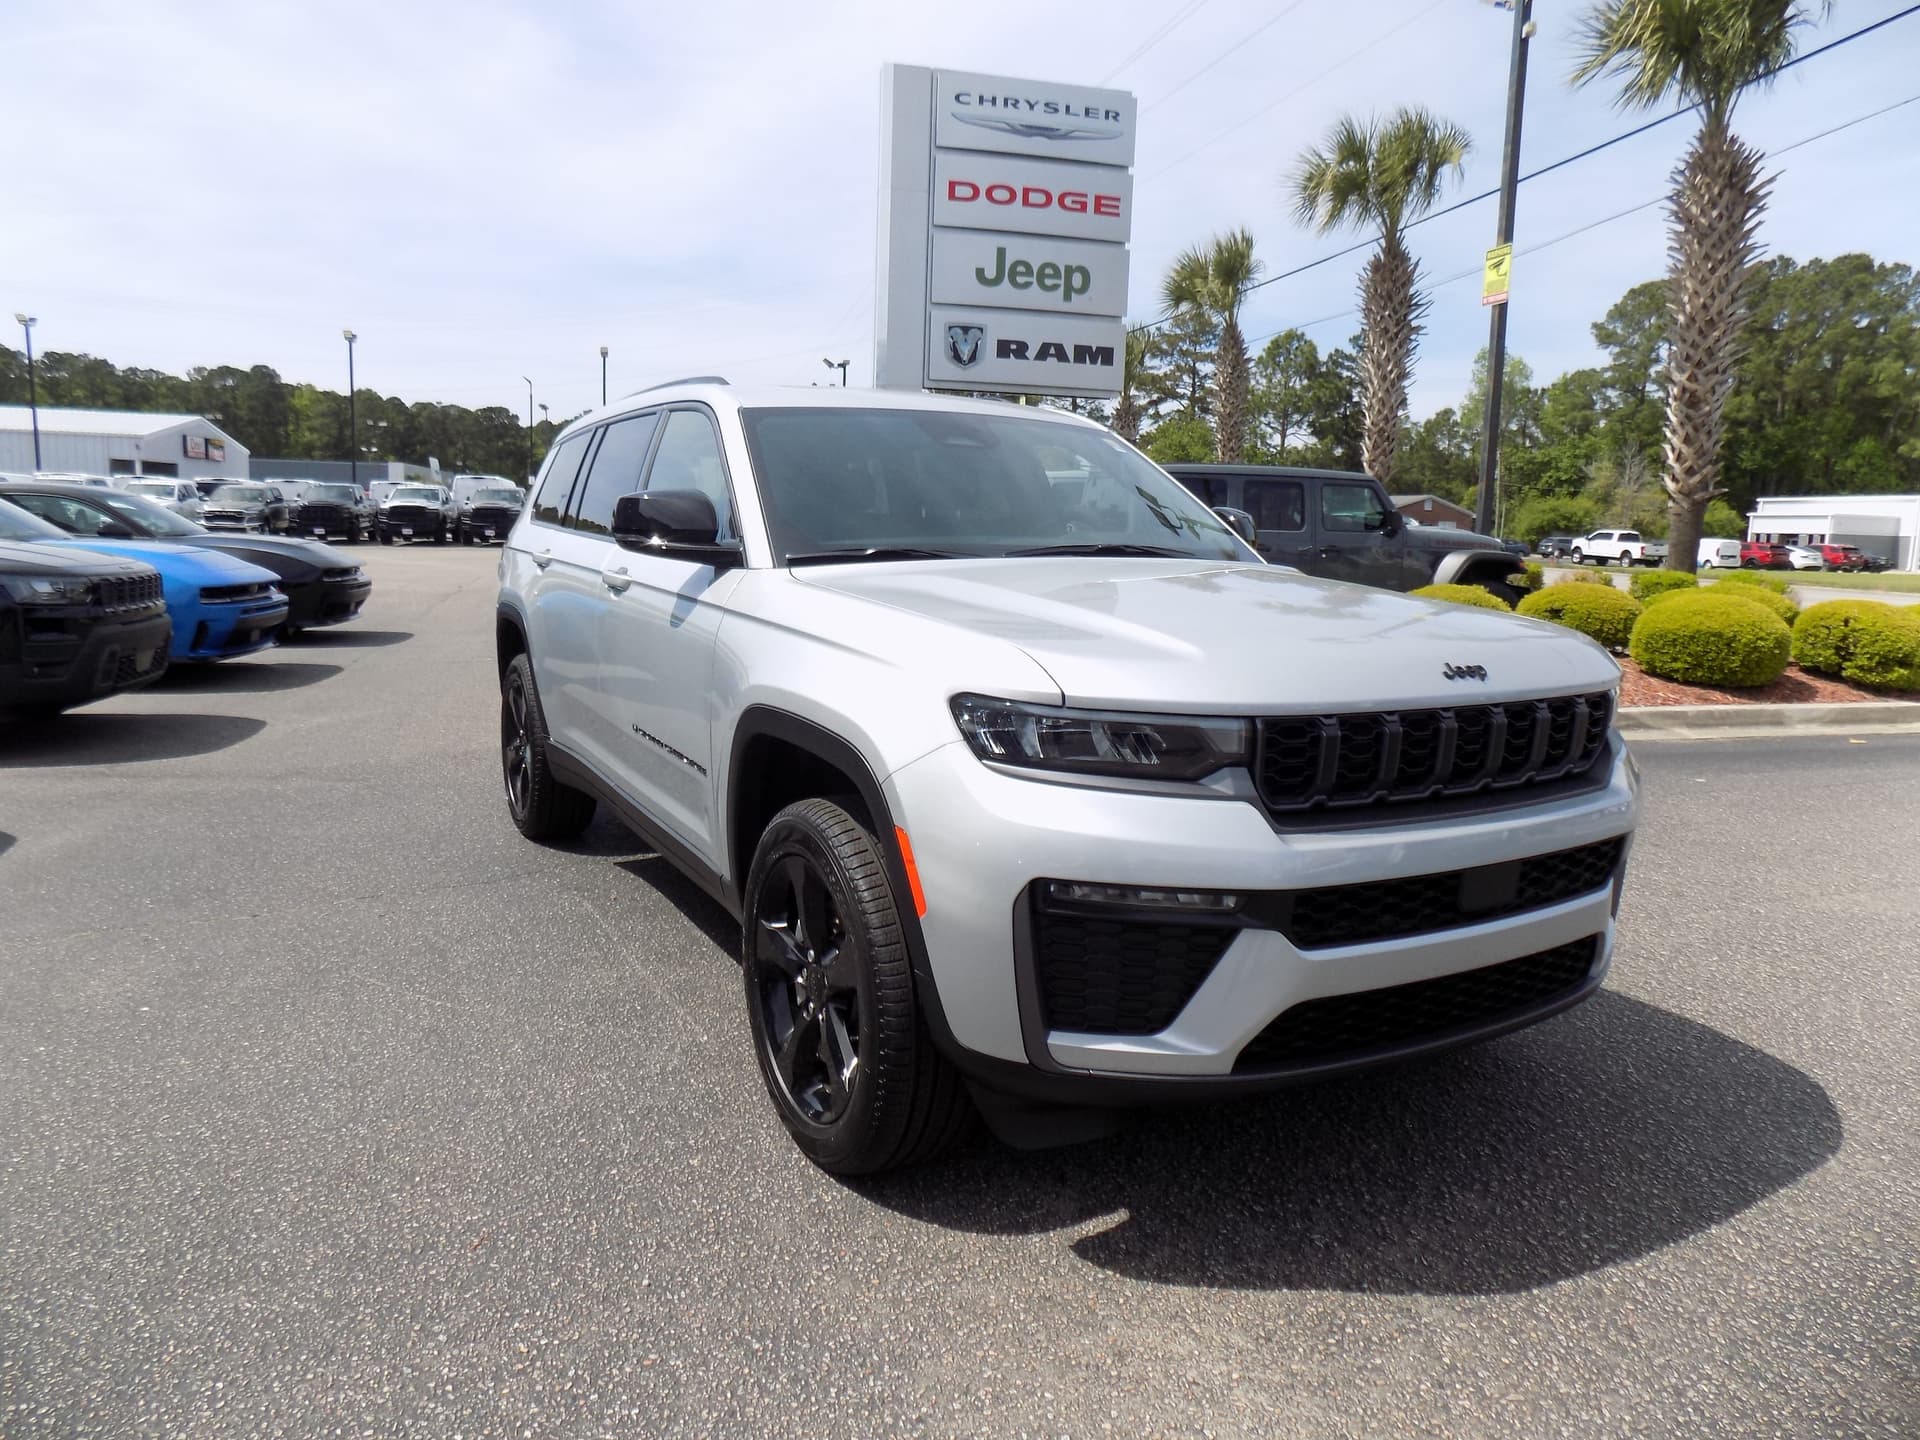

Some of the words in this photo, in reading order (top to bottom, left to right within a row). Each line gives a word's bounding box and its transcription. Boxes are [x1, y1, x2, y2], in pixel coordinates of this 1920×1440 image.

[954, 92, 1121, 122] CHRYSLER
[947, 180, 1121, 217] DODGE
[975, 247, 1091, 302] Jeep
[995, 338, 1115, 367] RAM
[1442, 662, 1488, 682] Jeep
